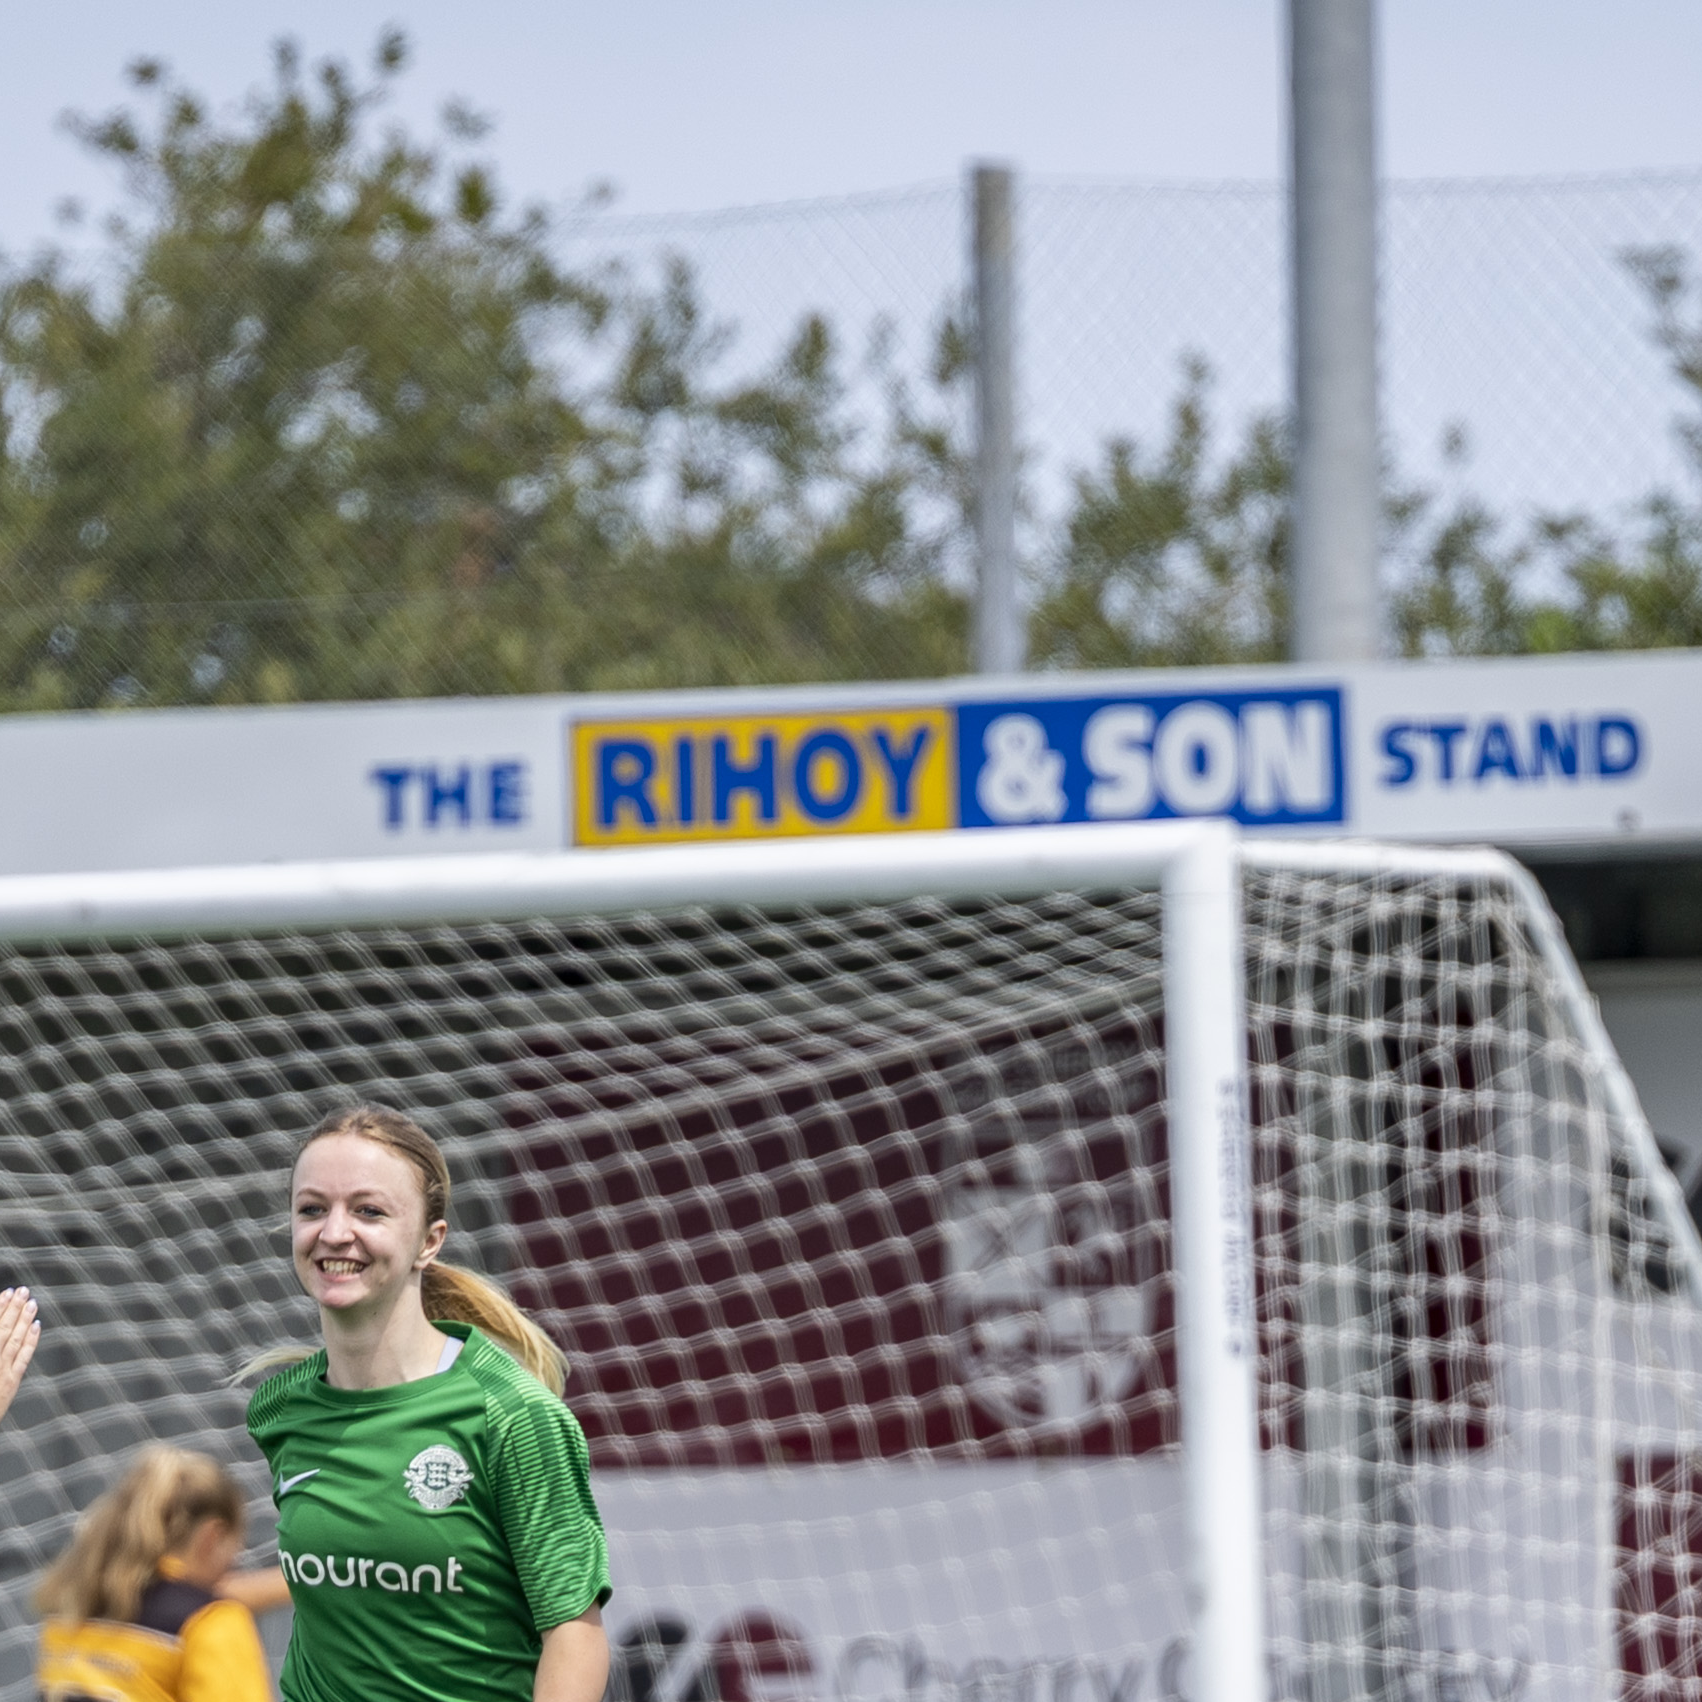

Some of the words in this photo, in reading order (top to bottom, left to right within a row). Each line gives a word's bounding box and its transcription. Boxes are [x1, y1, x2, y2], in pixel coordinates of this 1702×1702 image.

[371, 758, 527, 833] THE
[597, 723, 940, 830] RIHOY
[978, 712, 1067, 824] &
[1082, 700, 1340, 818] SON
[1377, 715, 1644, 788] STAND
